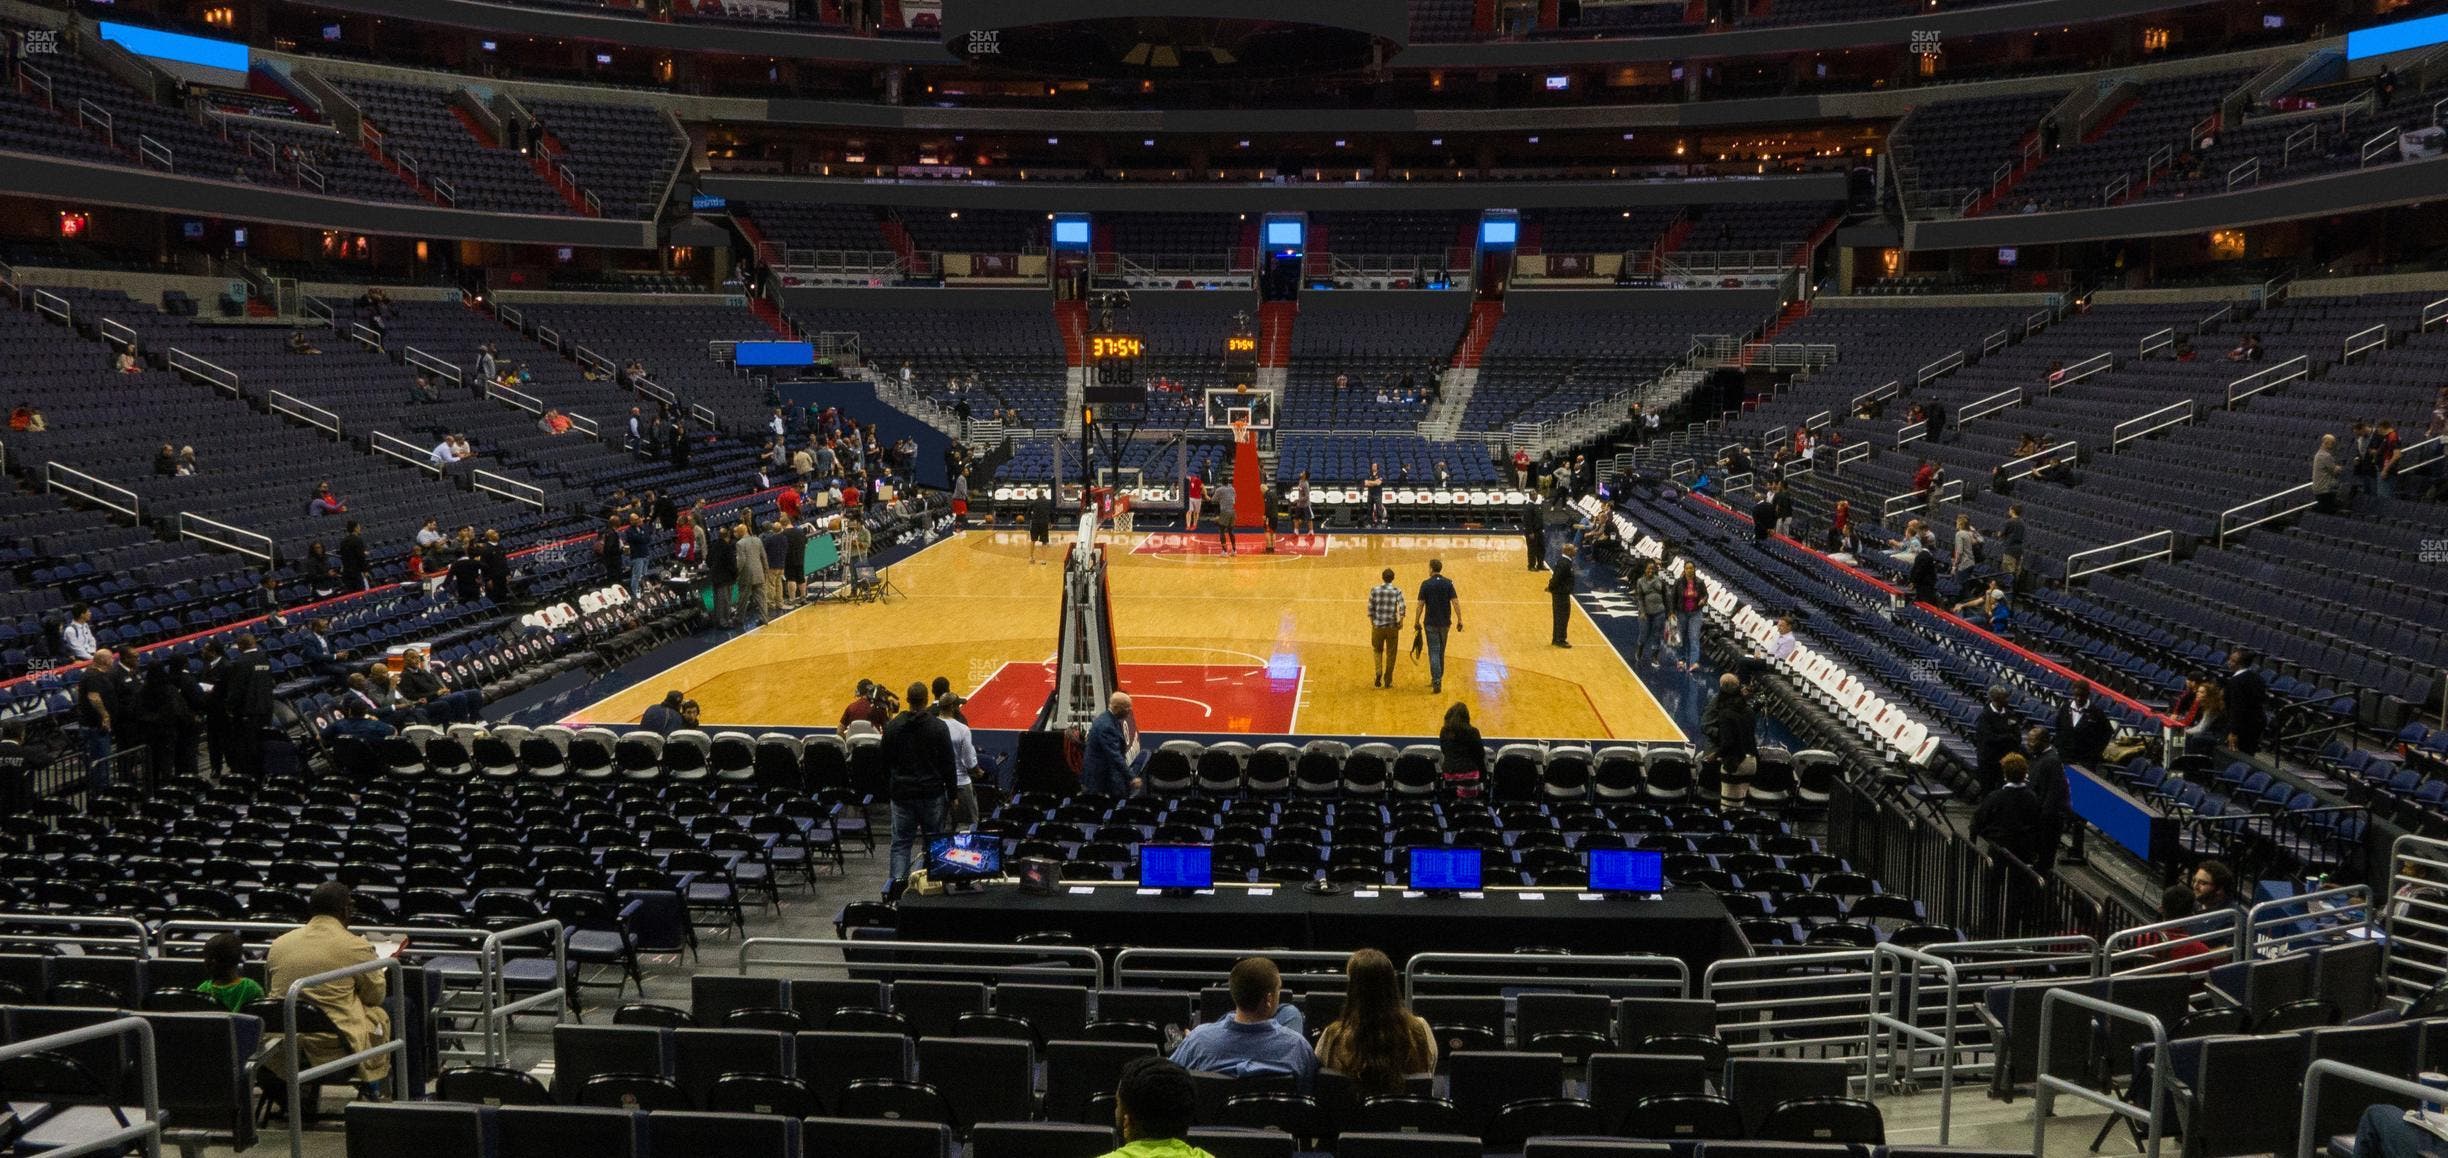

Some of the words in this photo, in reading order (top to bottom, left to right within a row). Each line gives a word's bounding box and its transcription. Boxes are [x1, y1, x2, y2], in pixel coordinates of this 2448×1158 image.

[64, 220, 77, 233] 25
[1092, 337, 1140, 357] 37:54
[1228, 339, 1254, 352] 37:54
